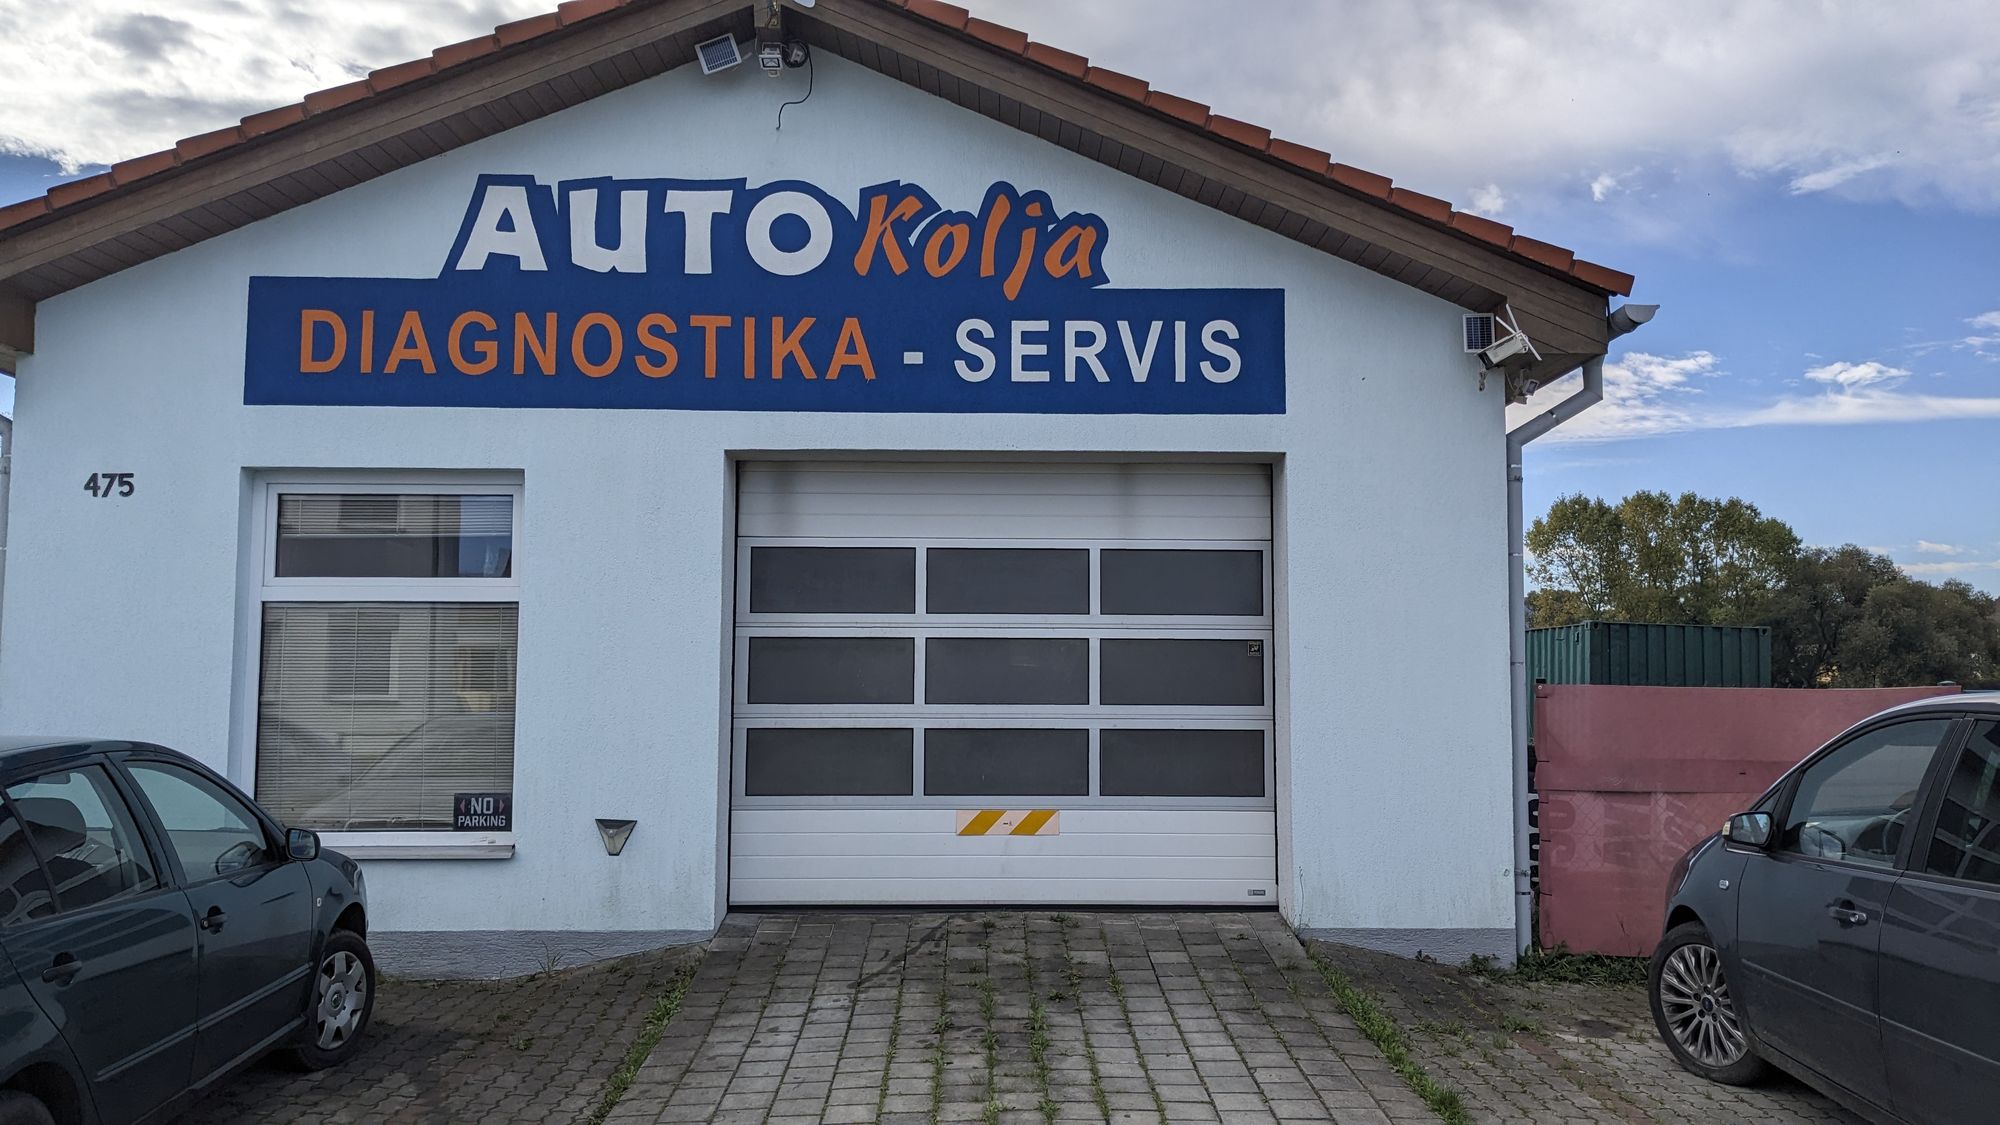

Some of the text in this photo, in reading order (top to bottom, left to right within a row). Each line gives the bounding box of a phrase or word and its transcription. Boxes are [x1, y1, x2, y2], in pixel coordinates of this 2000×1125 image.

[455, 185, 1097, 301] AUTO Kolja
[299, 309, 1242, 384] DIAGNOSTIKA - SERVIS
[83, 472, 135, 498] 475
[470, 797, 494, 814] NO
[458, 815, 506, 827] PARKING
